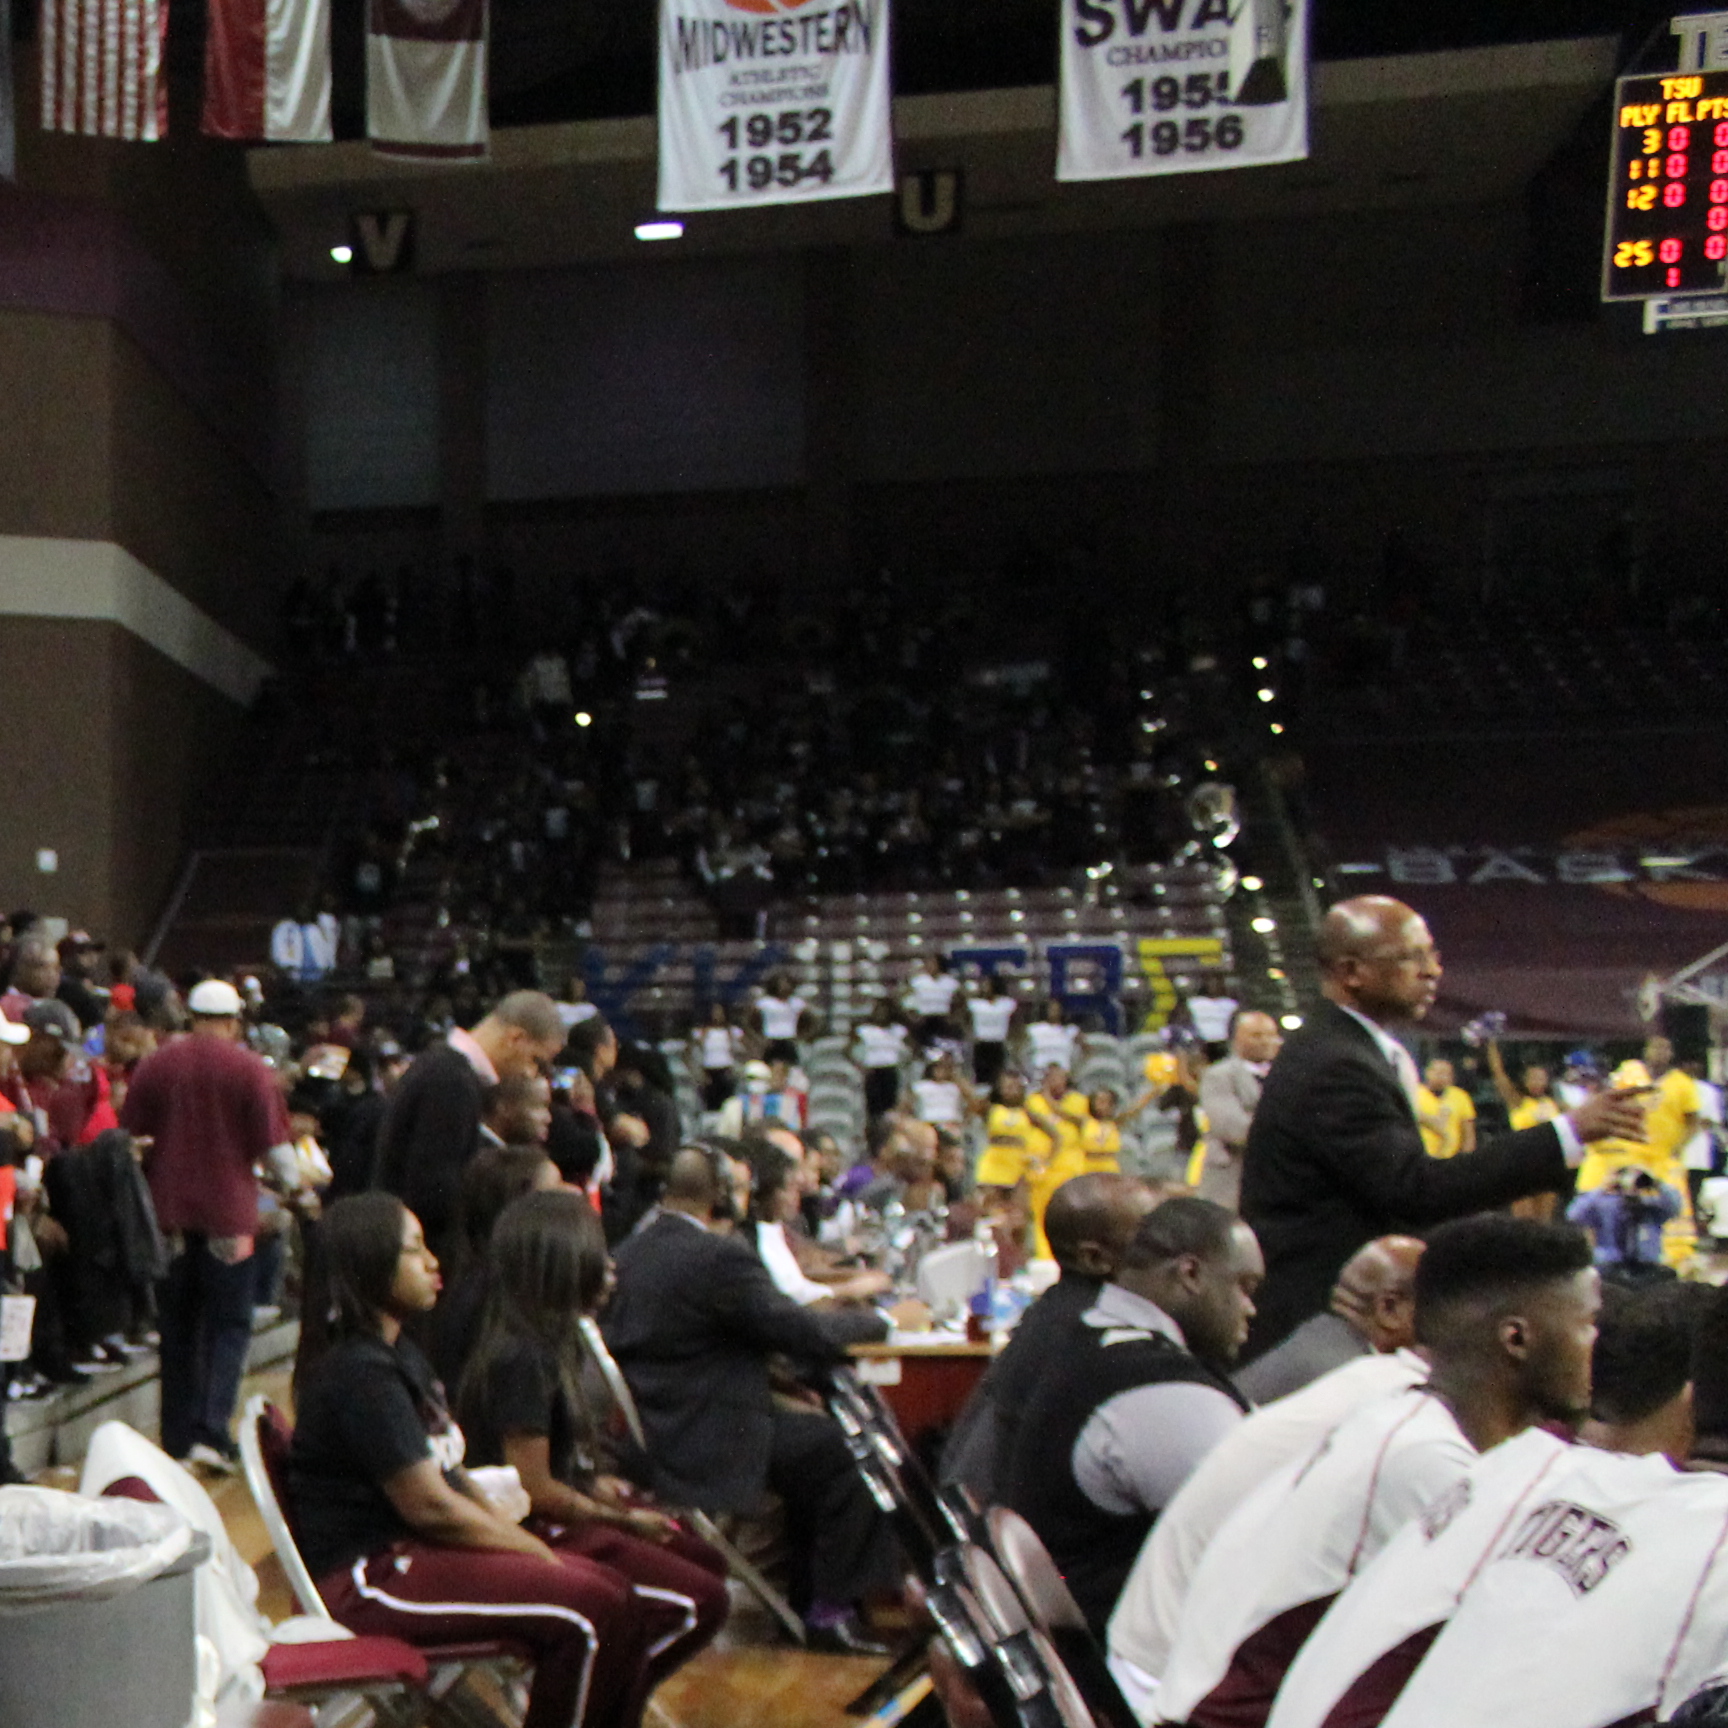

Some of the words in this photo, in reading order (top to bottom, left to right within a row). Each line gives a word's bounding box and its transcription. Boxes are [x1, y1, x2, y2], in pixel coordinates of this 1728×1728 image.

[674, 4, 871, 74] MIDWESTERN
[1075, 0, 1292, 47] SWA
[1106, 39, 1228, 67] CHAMPIO
[1660, 76, 1704, 100] TSU
[718, 107, 833, 149] 1952
[1619, 103, 1662, 128] PLY
[1666, 101, 1695, 124] FL
[1121, 115, 1244, 158] 1956
[1642, 128, 1663, 154] 3
[1668, 126, 1690, 151] 0
[718, 149, 835, 191] 1954
[1629, 157, 1661, 179] 11
[1666, 153, 1688, 178] 0
[900, 175, 958, 232] U
[1627, 184, 1659, 211] 12
[1663, 181, 1687, 208] 0
[355, 212, 408, 270] V
[1613, 239, 1655, 268] 25
[1659, 238, 1683, 264] 0
[1704, 234, 1728, 260] 0
[1498, 1500, 1634, 1600] TIGERS
